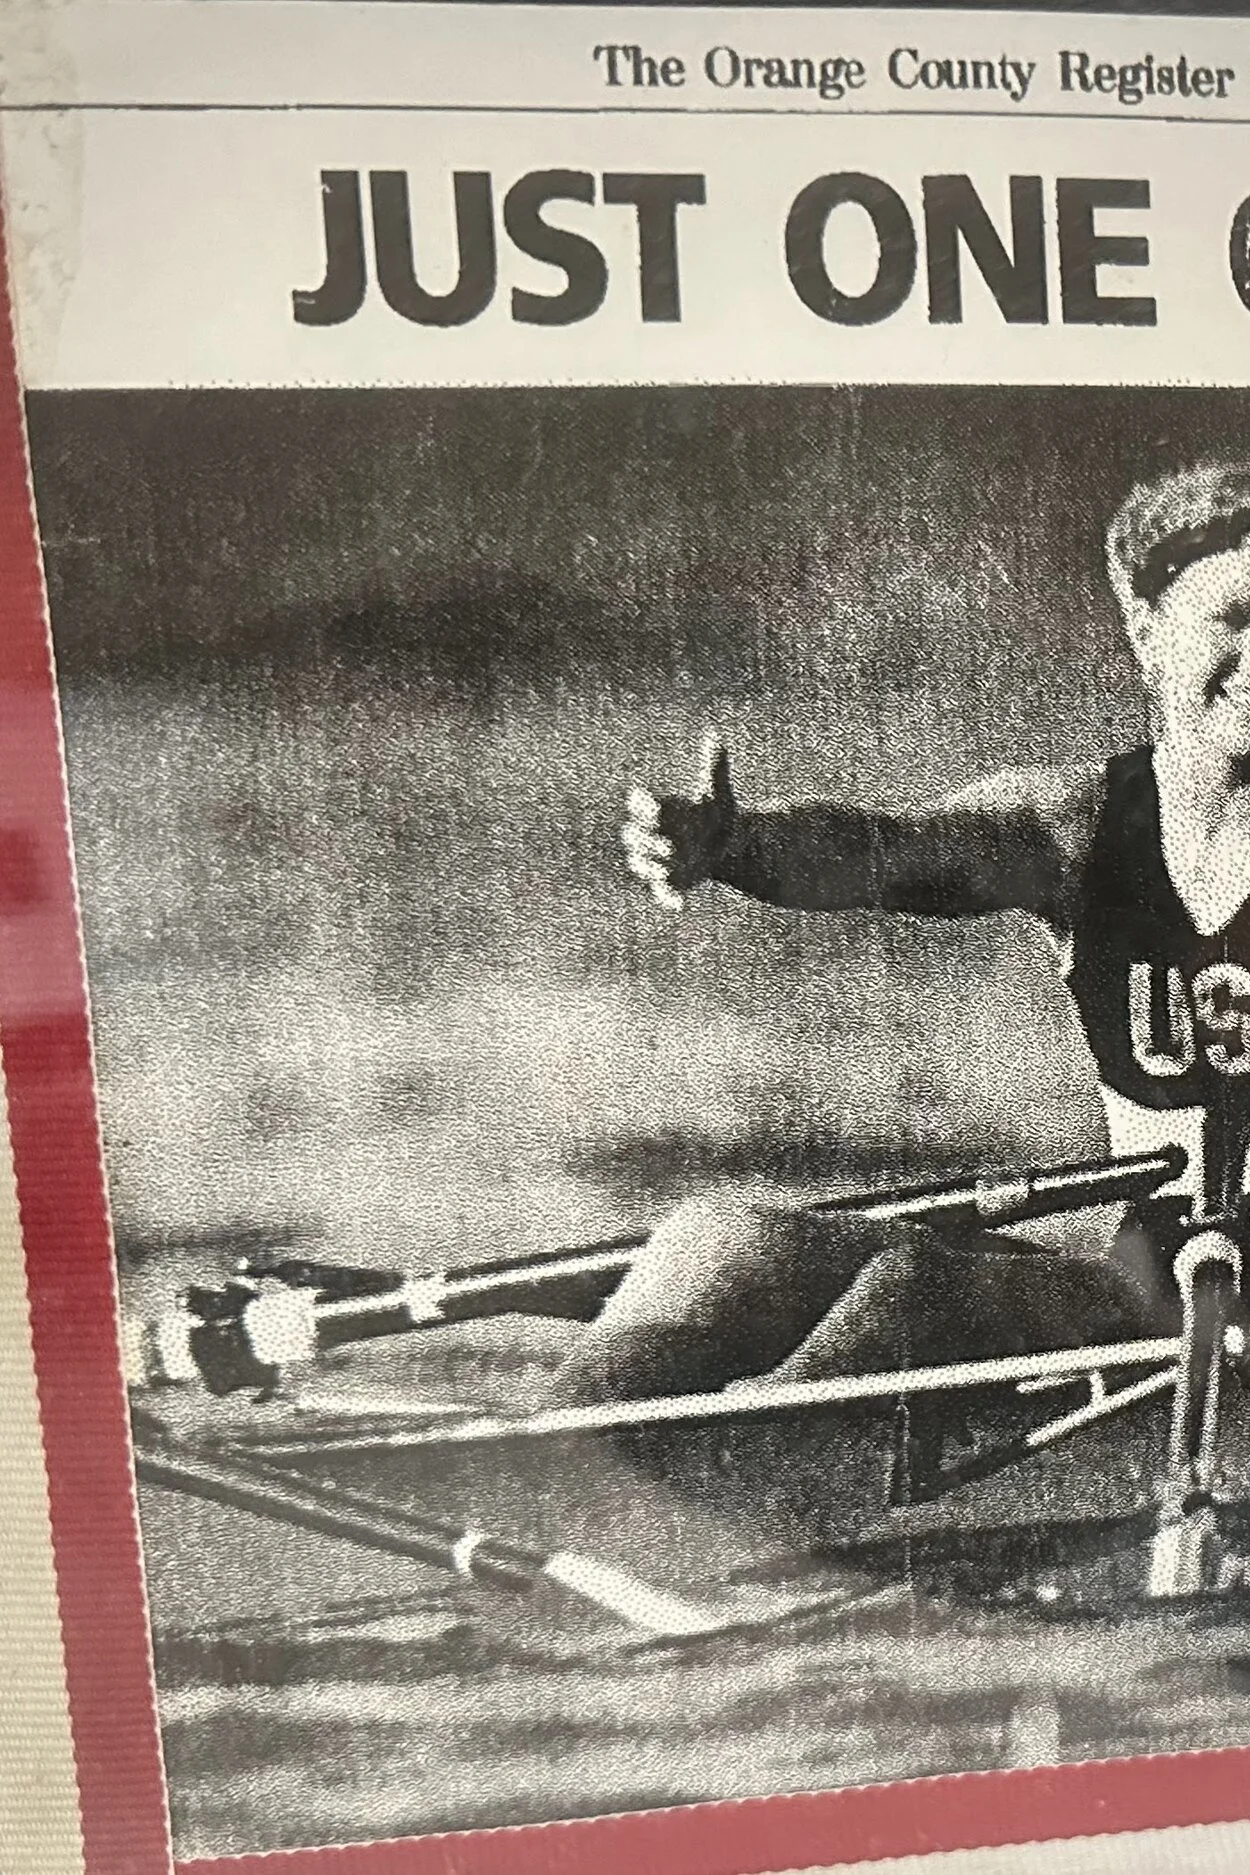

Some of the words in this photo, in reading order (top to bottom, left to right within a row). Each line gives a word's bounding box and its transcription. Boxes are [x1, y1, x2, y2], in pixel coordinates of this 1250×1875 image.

[592, 44, 686, 88] The
[704, 45, 867, 101] Orange
[888, 47, 1036, 101] County
[1058, 50, 1236, 105] Register
[292, 168, 707, 328] JUST
[784, 171, 1158, 328] ONE
